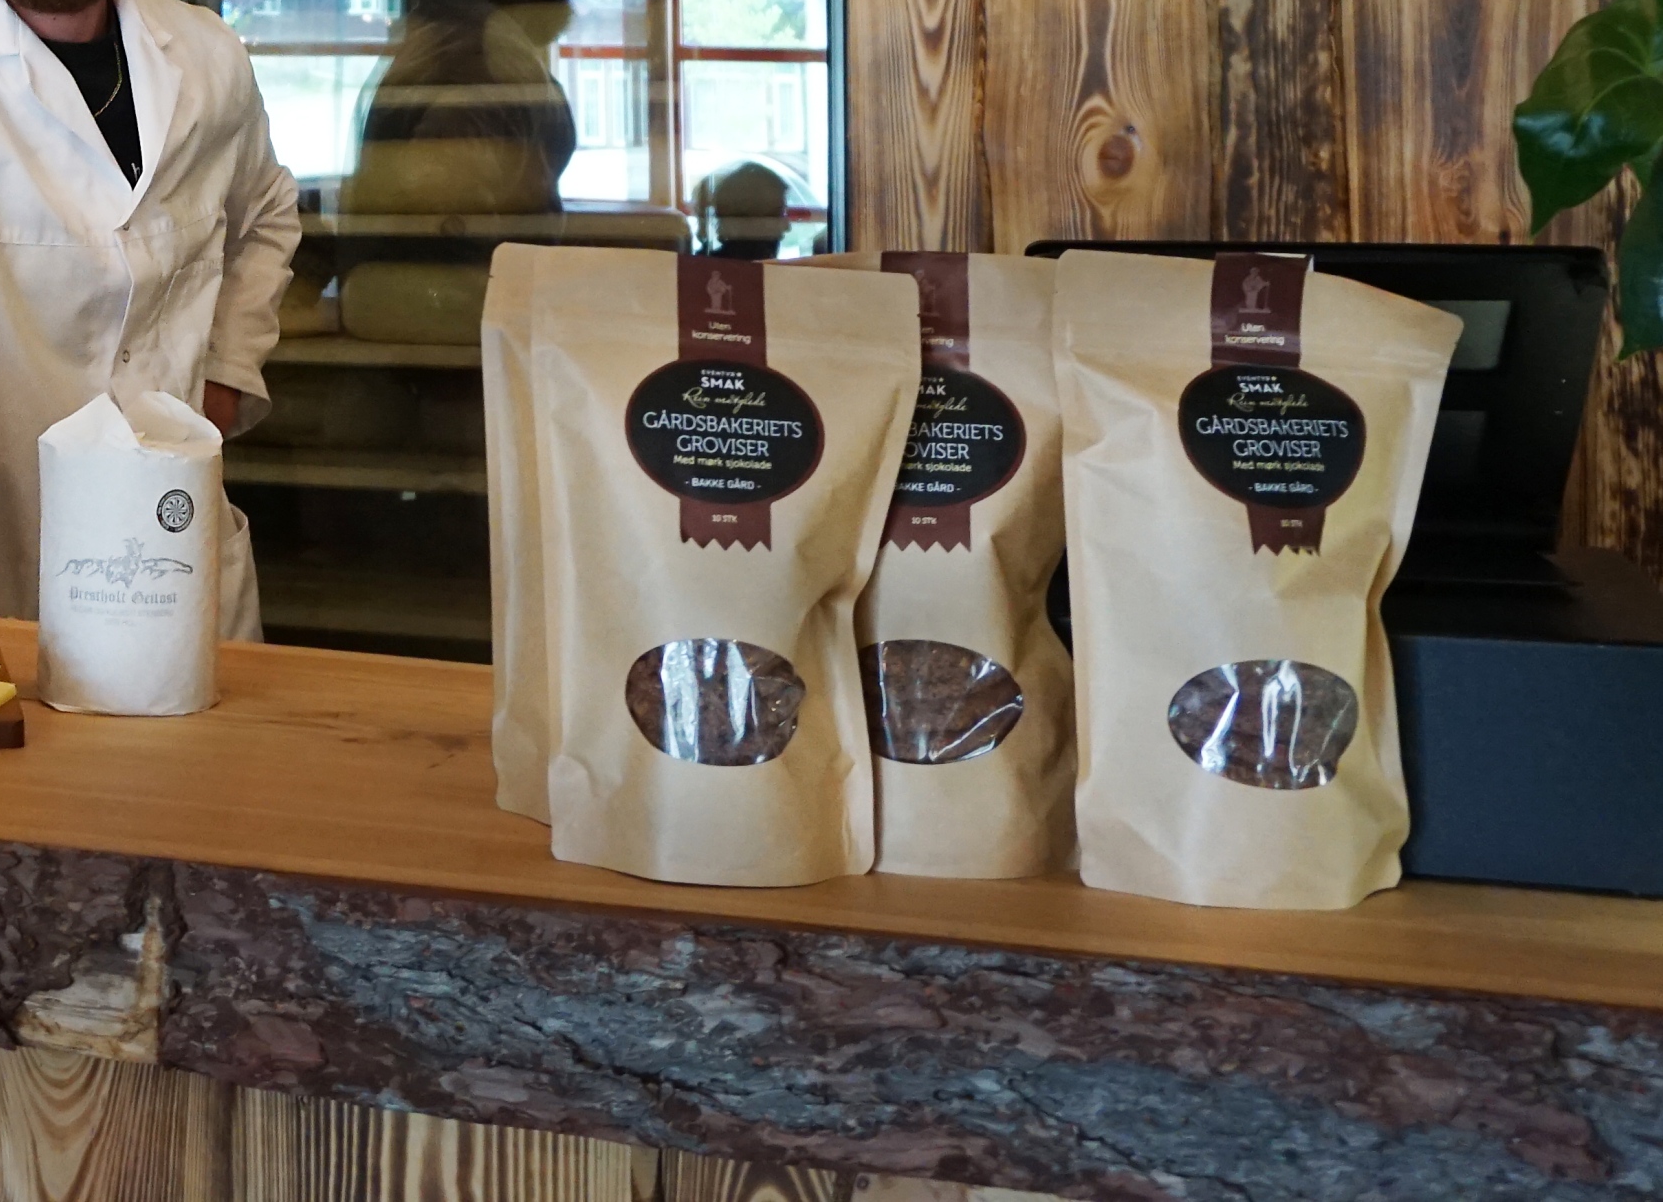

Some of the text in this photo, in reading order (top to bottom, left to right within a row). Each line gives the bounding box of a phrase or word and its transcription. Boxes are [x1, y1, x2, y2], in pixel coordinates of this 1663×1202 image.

[708, 321, 732, 331] Uten
[1240, 322, 1265, 333] Uten
[691, 330, 752, 345] konservering
[1224, 334, 1285, 346] konservering
[700, 376, 745, 391] SMAK
[918, 384, 946, 396] MAK
[1238, 382, 1284, 394] SMAK
[642, 410, 803, 439] GÅRDSBAKERIETS
[908, 421, 1004, 441] BAKERIETS
[1195, 414, 1349, 439] GÅRDSBAKERIETS
[676, 435, 770, 457] GROVISER
[903, 441, 970, 460] OVISER
[1232, 439, 1323, 459] GROVISER
[673, 454, 772, 470] Med mørk sjokolade
[925, 461, 973, 473] sjokolade
[1232, 460, 1325, 472] Med mørk sjokolade
[691, 477, 755, 490] BAKKE GÅRD
[926, 480, 955, 493] GÅRD
[1254, 480, 1314, 494] BAKKE GÅRD
[712, 514, 738, 523] 10 STK
[911, 516, 937, 525] 10 STK
